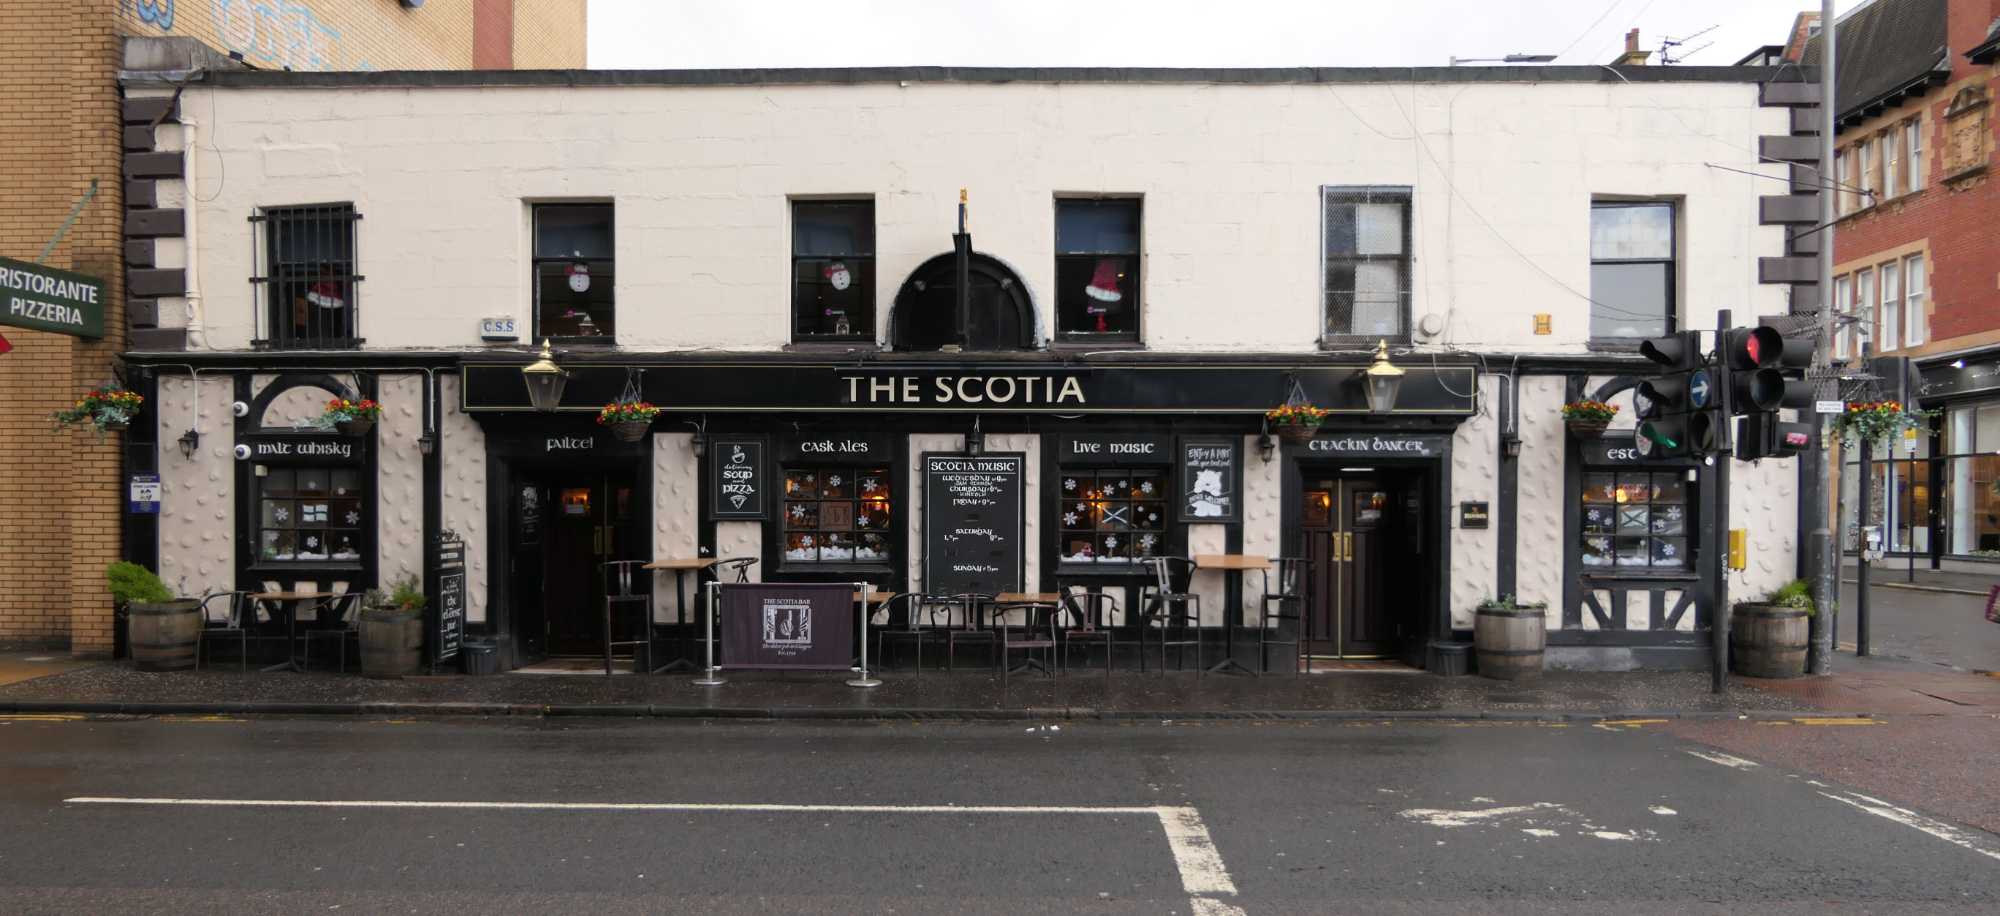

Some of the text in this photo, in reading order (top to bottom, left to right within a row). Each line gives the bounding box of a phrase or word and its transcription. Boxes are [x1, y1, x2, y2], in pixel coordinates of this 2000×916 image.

[0, 266, 98, 304] RISTORANTE
[10, 296, 83, 325] PIZZERIA
[842, 376, 1086, 403] THE SCOTIA
[931, 461, 1015, 472] SCOTIA MUSIC
[953, 565, 982, 573] SUNDAY
